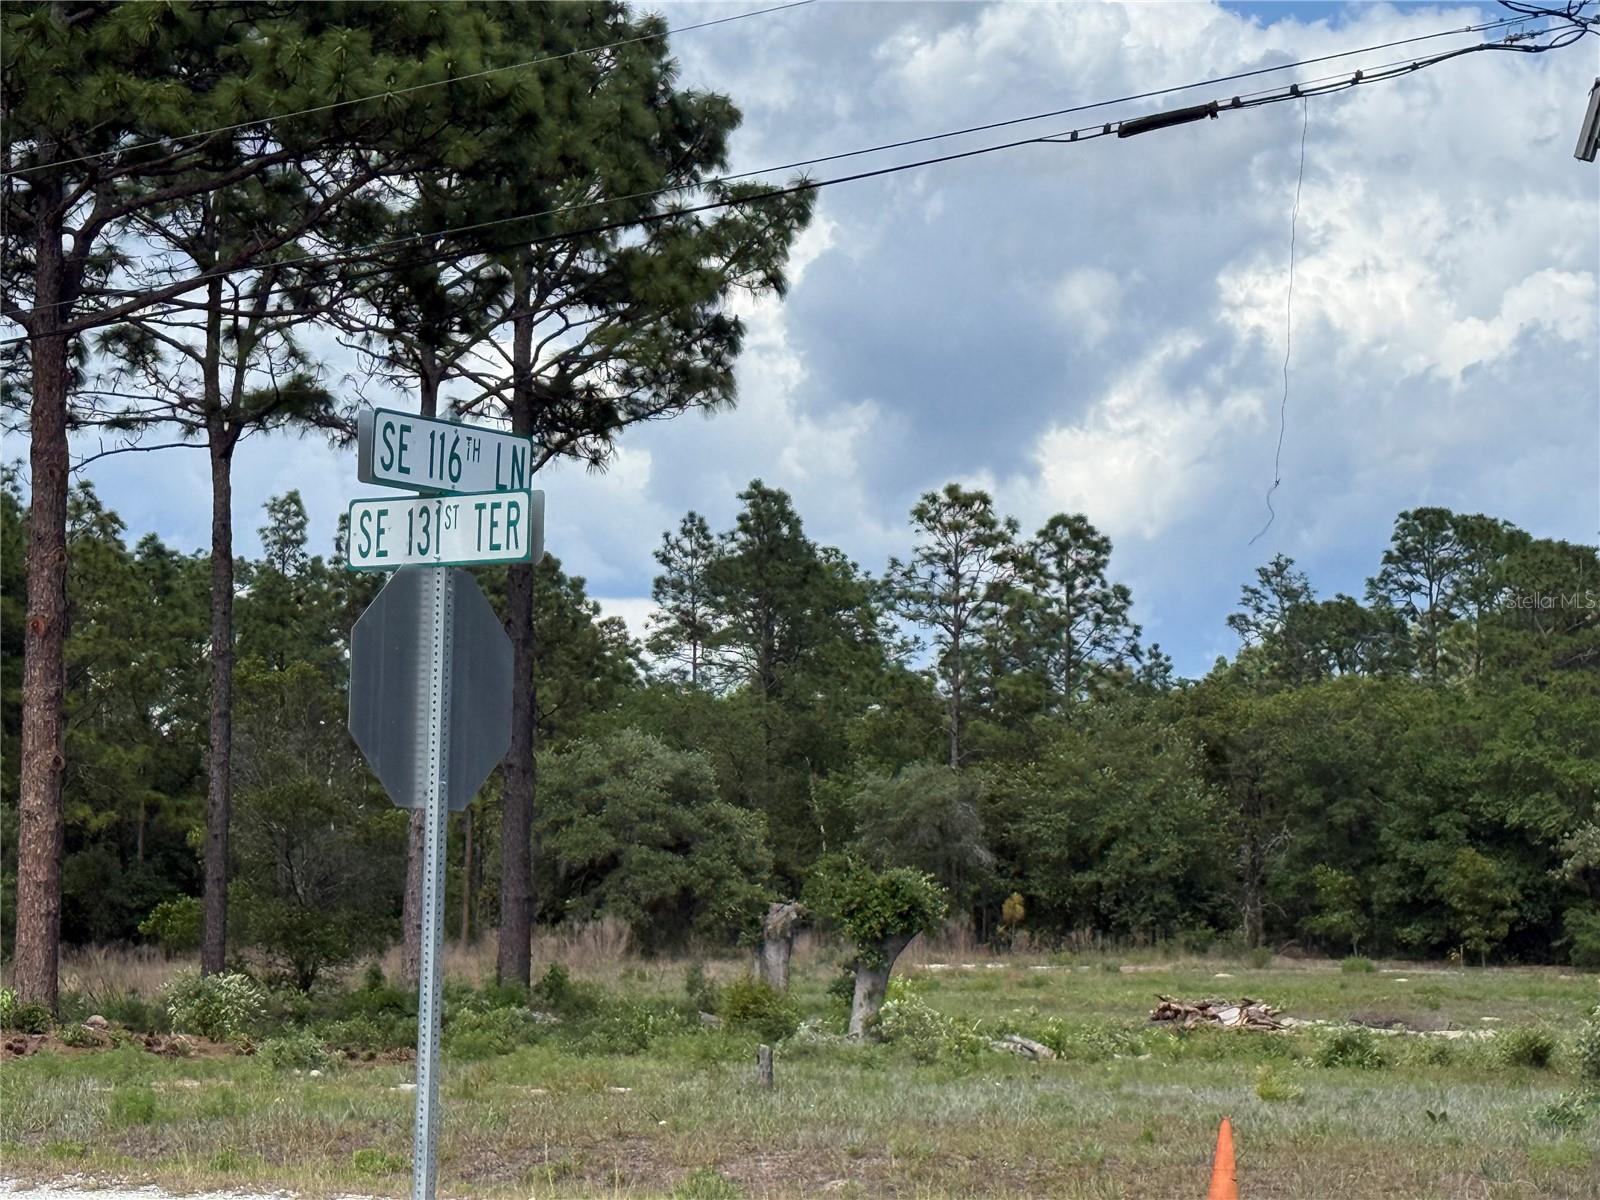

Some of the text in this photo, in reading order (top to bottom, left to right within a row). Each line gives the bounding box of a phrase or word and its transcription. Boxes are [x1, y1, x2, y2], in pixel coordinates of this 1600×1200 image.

[380, 421, 526, 490] SE 116TH LN
[358, 500, 521, 559] SE 131ST TER
